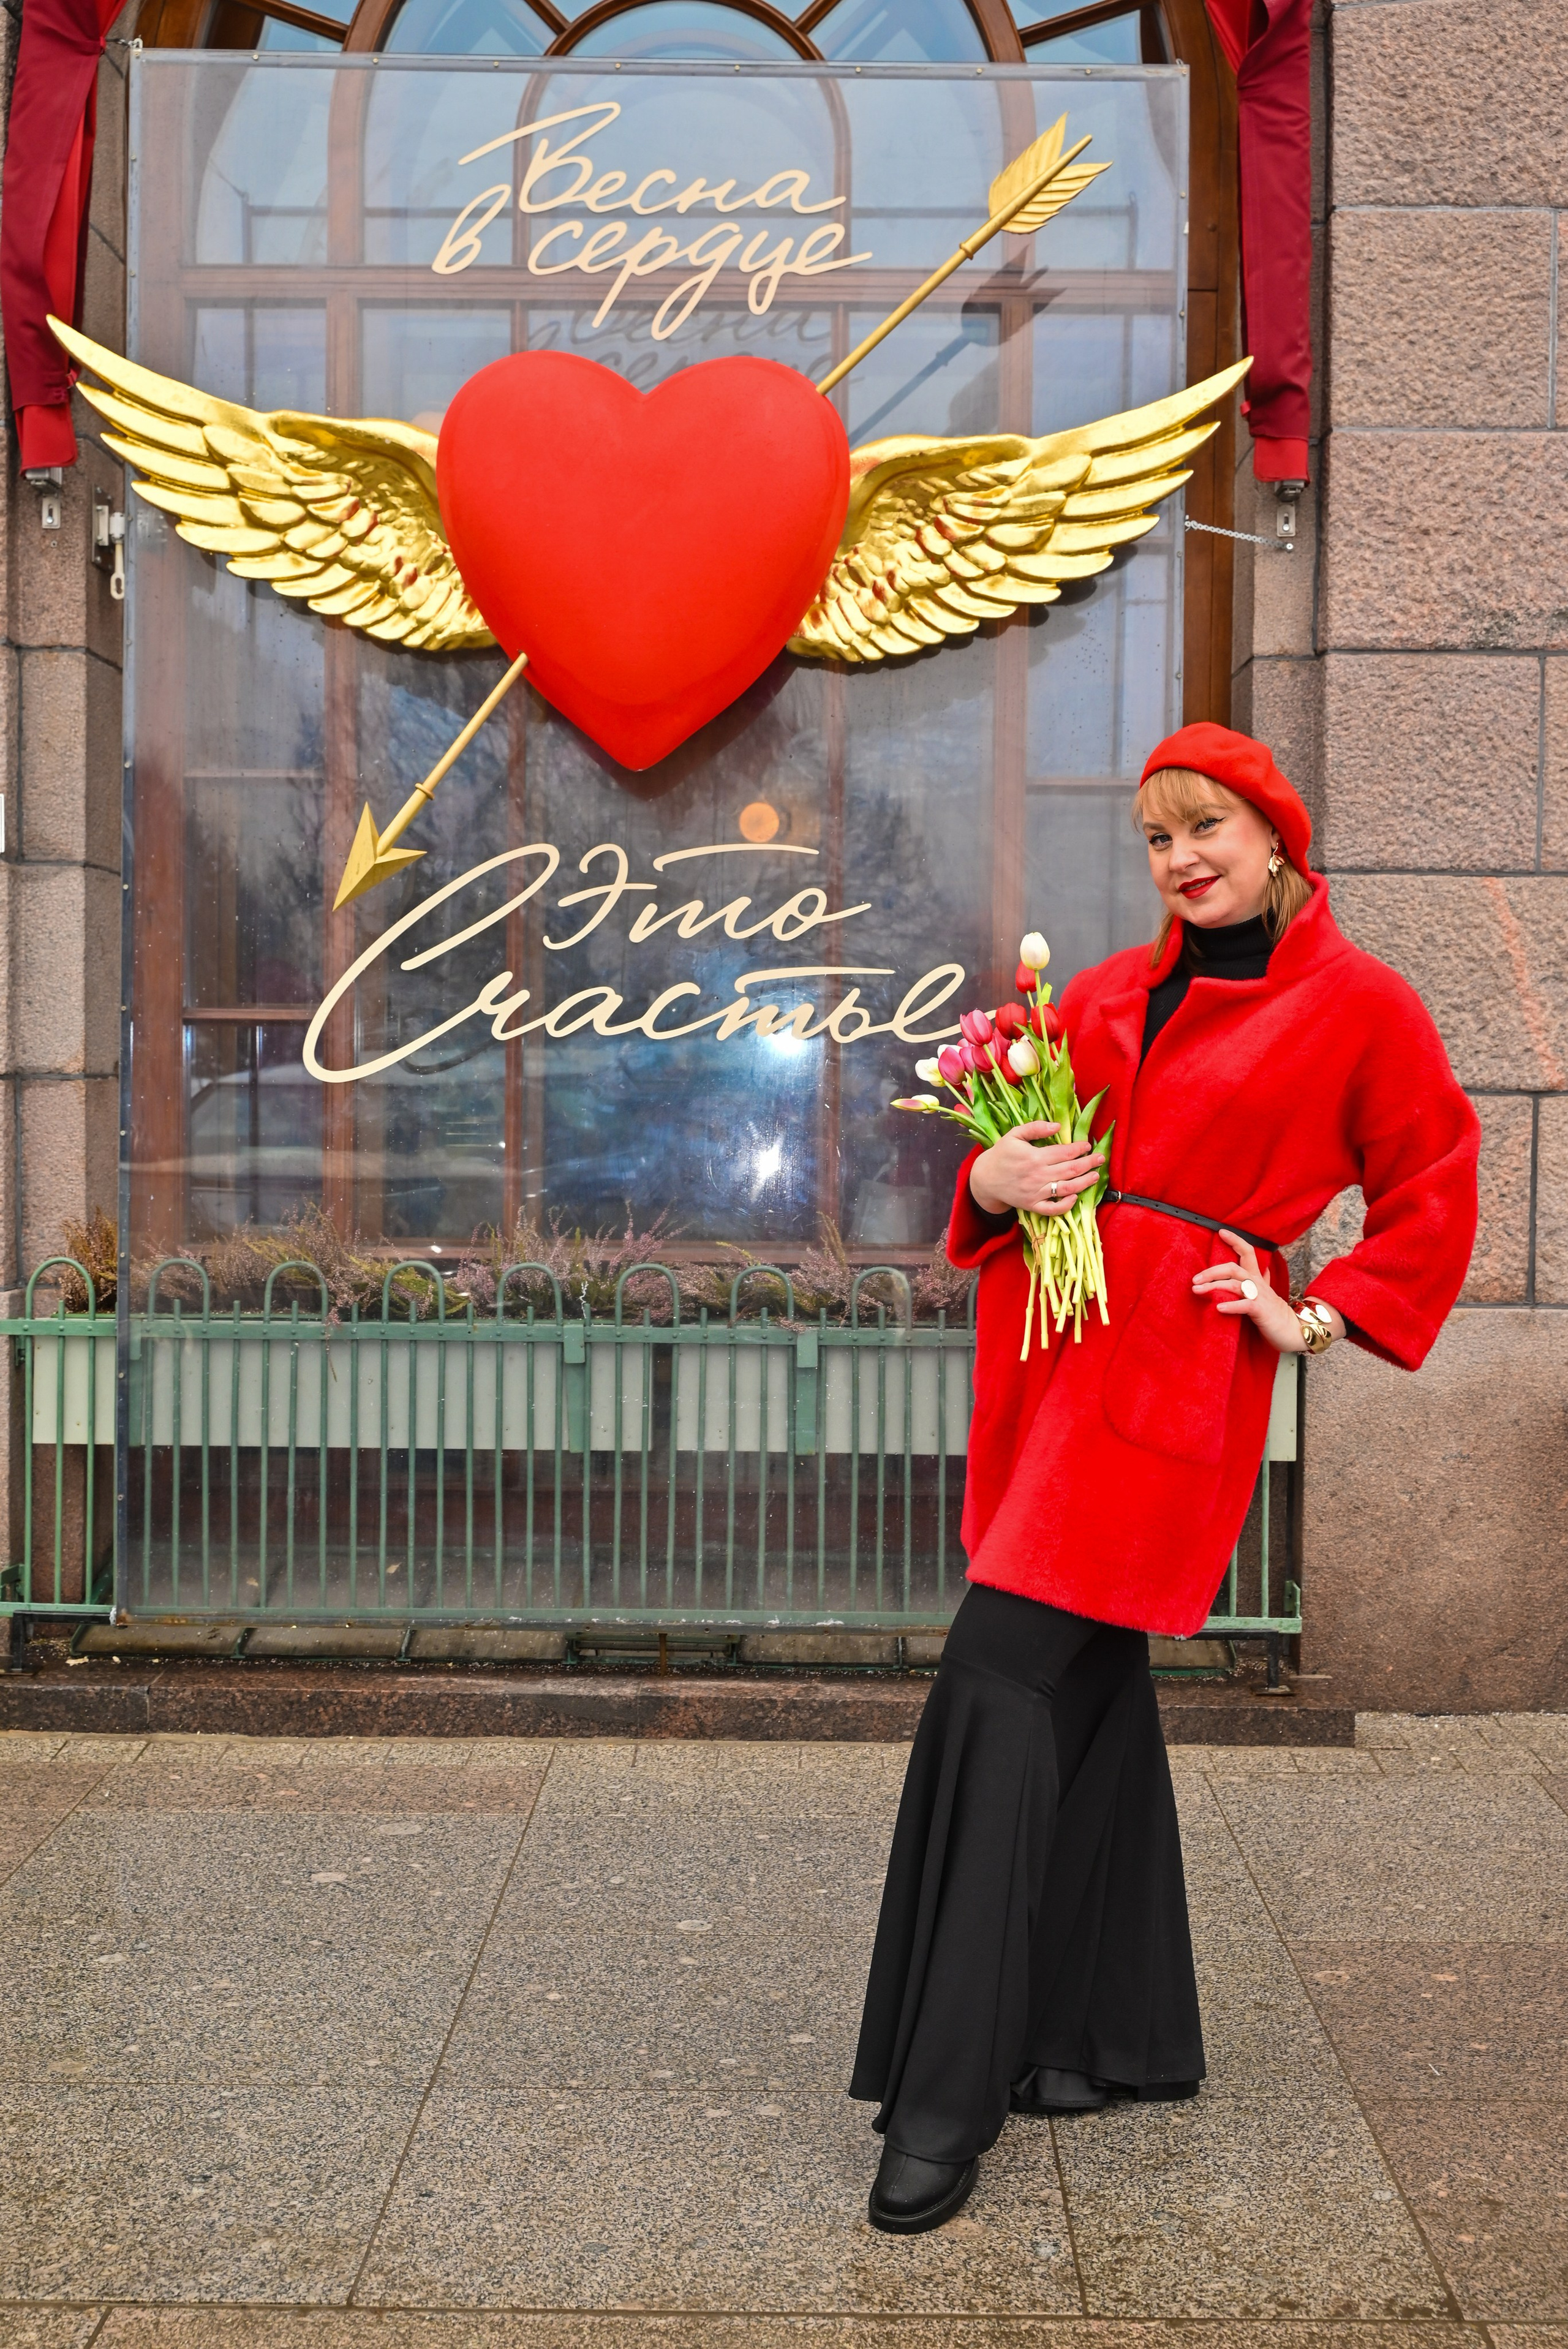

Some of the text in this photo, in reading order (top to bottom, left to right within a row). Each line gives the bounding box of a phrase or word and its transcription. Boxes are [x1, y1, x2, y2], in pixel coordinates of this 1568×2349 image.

[458, 102, 846, 215] Весна
[431, 184, 873, 341] в сердце
[302, 843, 997, 1084] Счастье
[543, 843, 872, 950] Это
